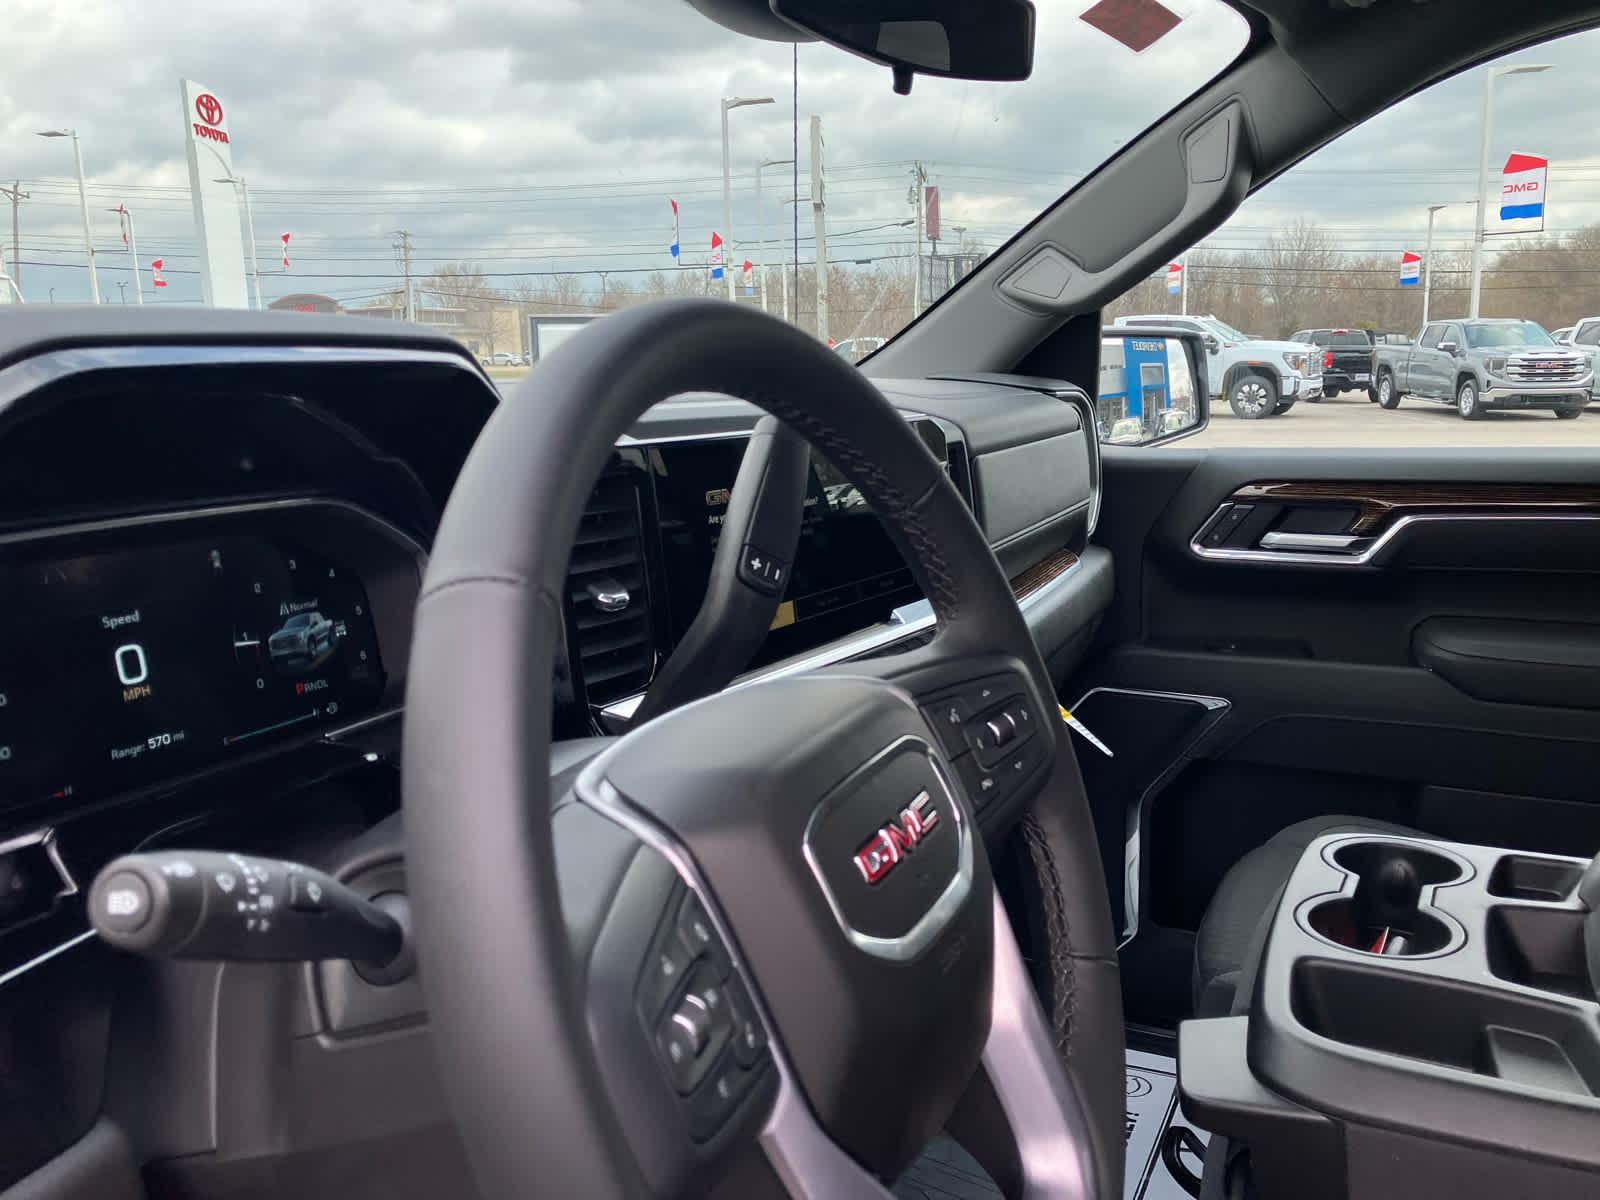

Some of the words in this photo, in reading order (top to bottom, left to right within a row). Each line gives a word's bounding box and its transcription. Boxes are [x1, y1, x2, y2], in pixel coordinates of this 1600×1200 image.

[193, 123, 229, 143] TOYOTA
[102, 610, 140, 629] Speed
[115, 644, 148, 685] 0
[123, 686, 151, 702] MPH
[148, 733, 171, 749] 570
[173, 730, 185, 741] mi
[853, 789, 939, 883] GMC
